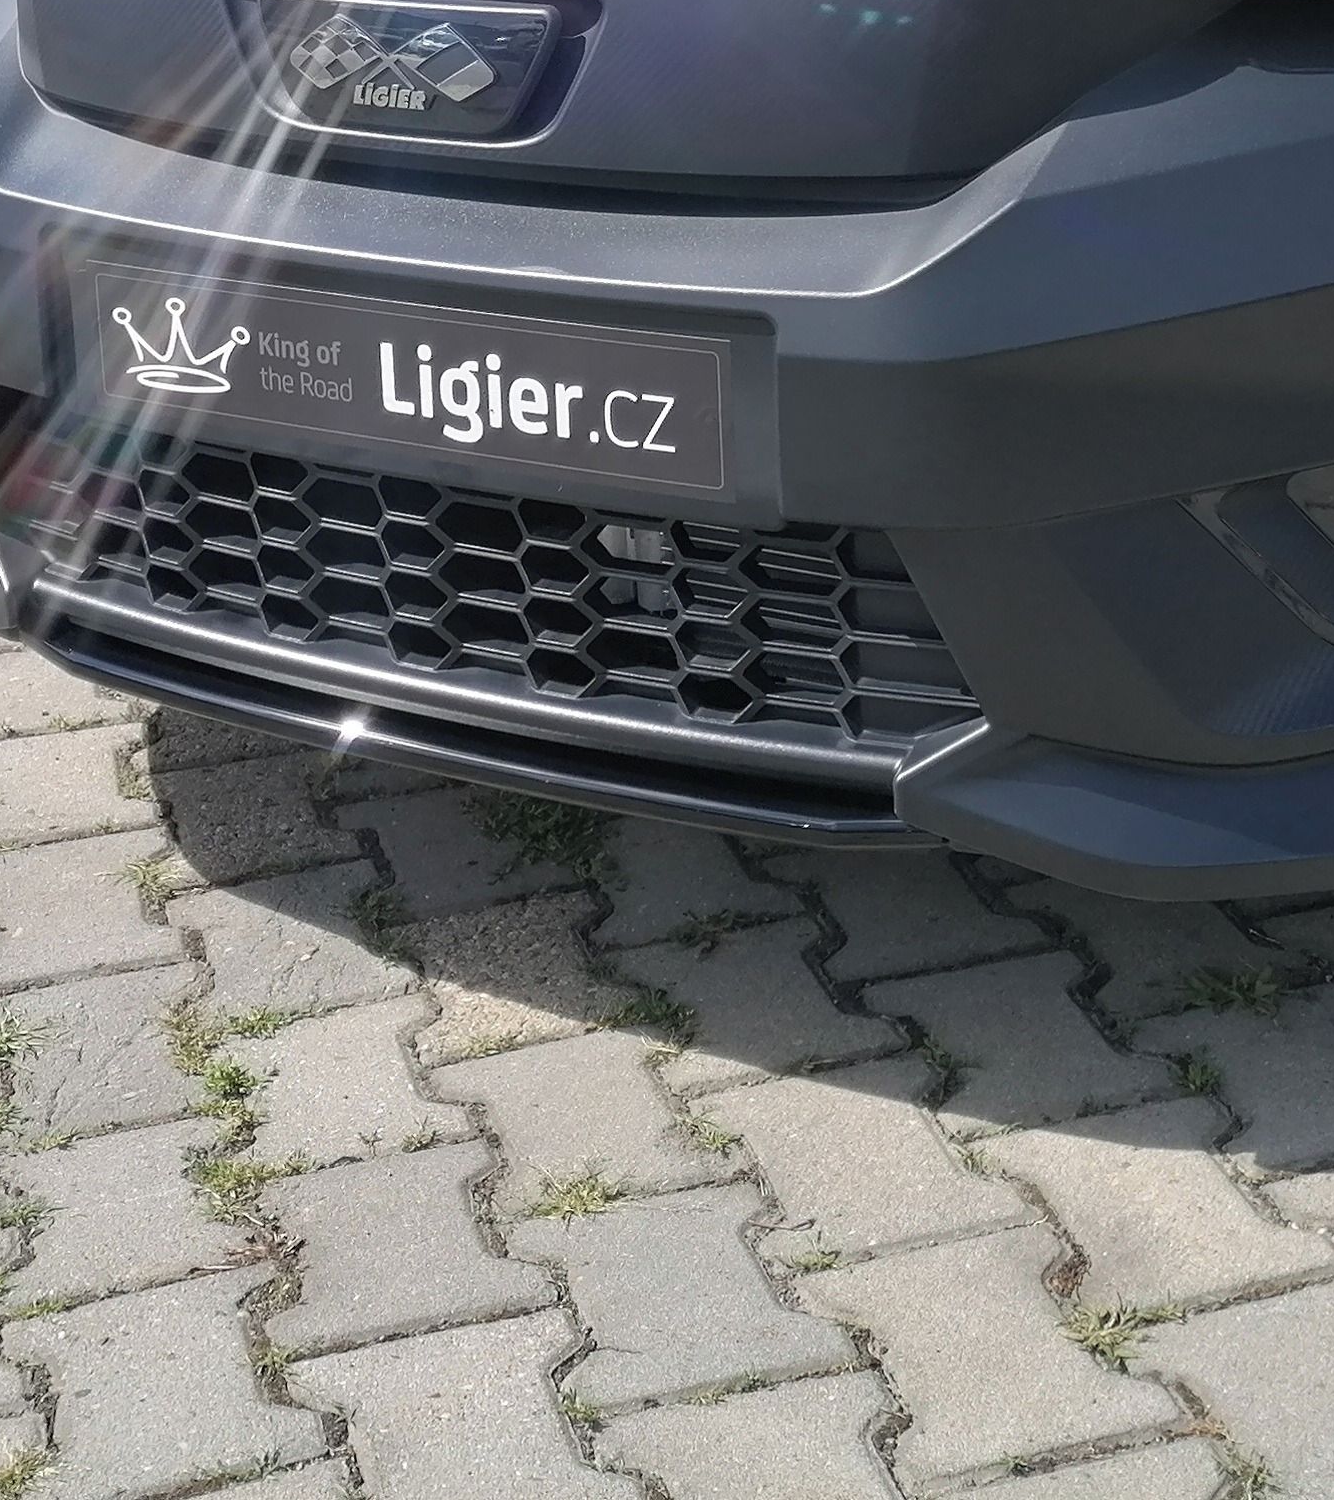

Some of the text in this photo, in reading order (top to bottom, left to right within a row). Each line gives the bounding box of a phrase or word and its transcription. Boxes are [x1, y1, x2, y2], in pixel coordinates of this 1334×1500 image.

[258, 331, 341, 367] King of
[259, 365, 352, 402] the Road
